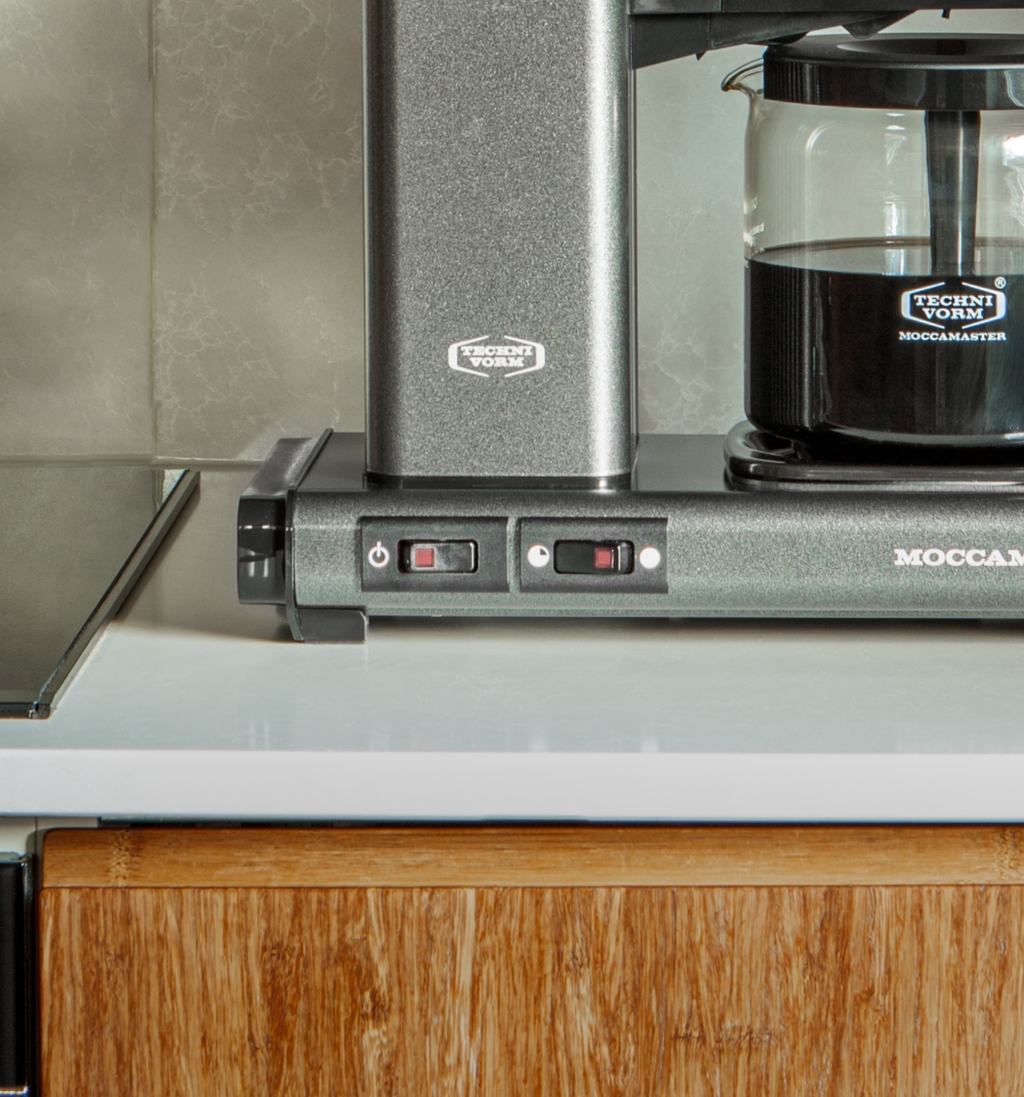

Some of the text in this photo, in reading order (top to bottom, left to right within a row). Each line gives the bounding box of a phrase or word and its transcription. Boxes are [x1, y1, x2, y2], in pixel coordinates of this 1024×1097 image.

[914, 295, 993, 306] TECHNI
[922, 308, 984, 319] VORM
[899, 332, 1007, 341] MOCCAMASTER
[461, 346, 532, 356] TECHNI
[469, 357, 524, 367] VORM
